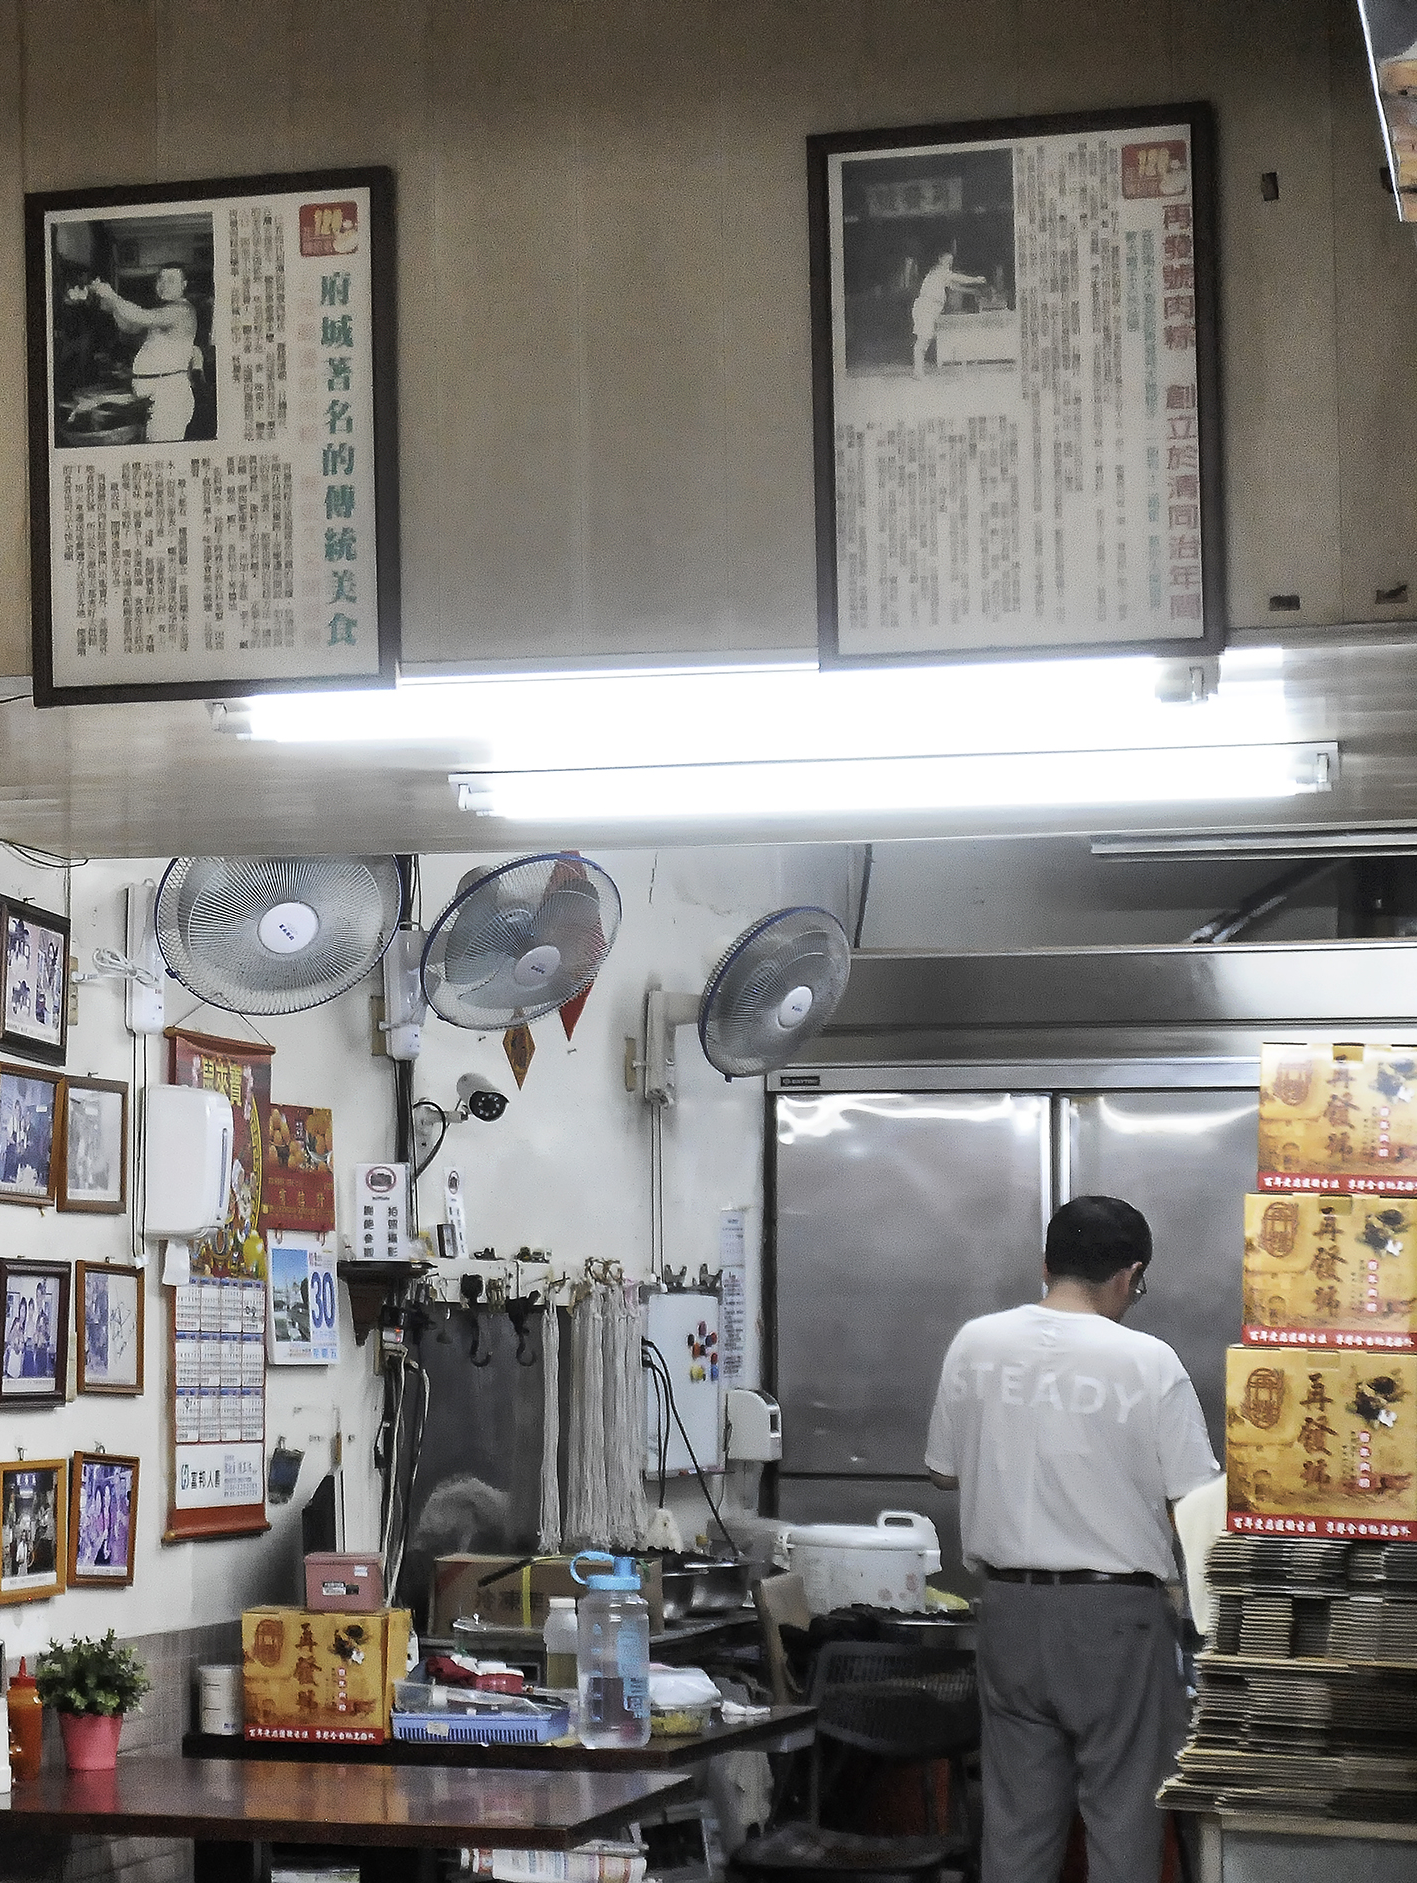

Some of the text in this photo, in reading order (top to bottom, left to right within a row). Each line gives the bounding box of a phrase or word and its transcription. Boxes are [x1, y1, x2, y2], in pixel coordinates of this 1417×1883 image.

[319, 271, 359, 648] 府城著名的傳統美食
[311, 1271, 336, 1329] 30
